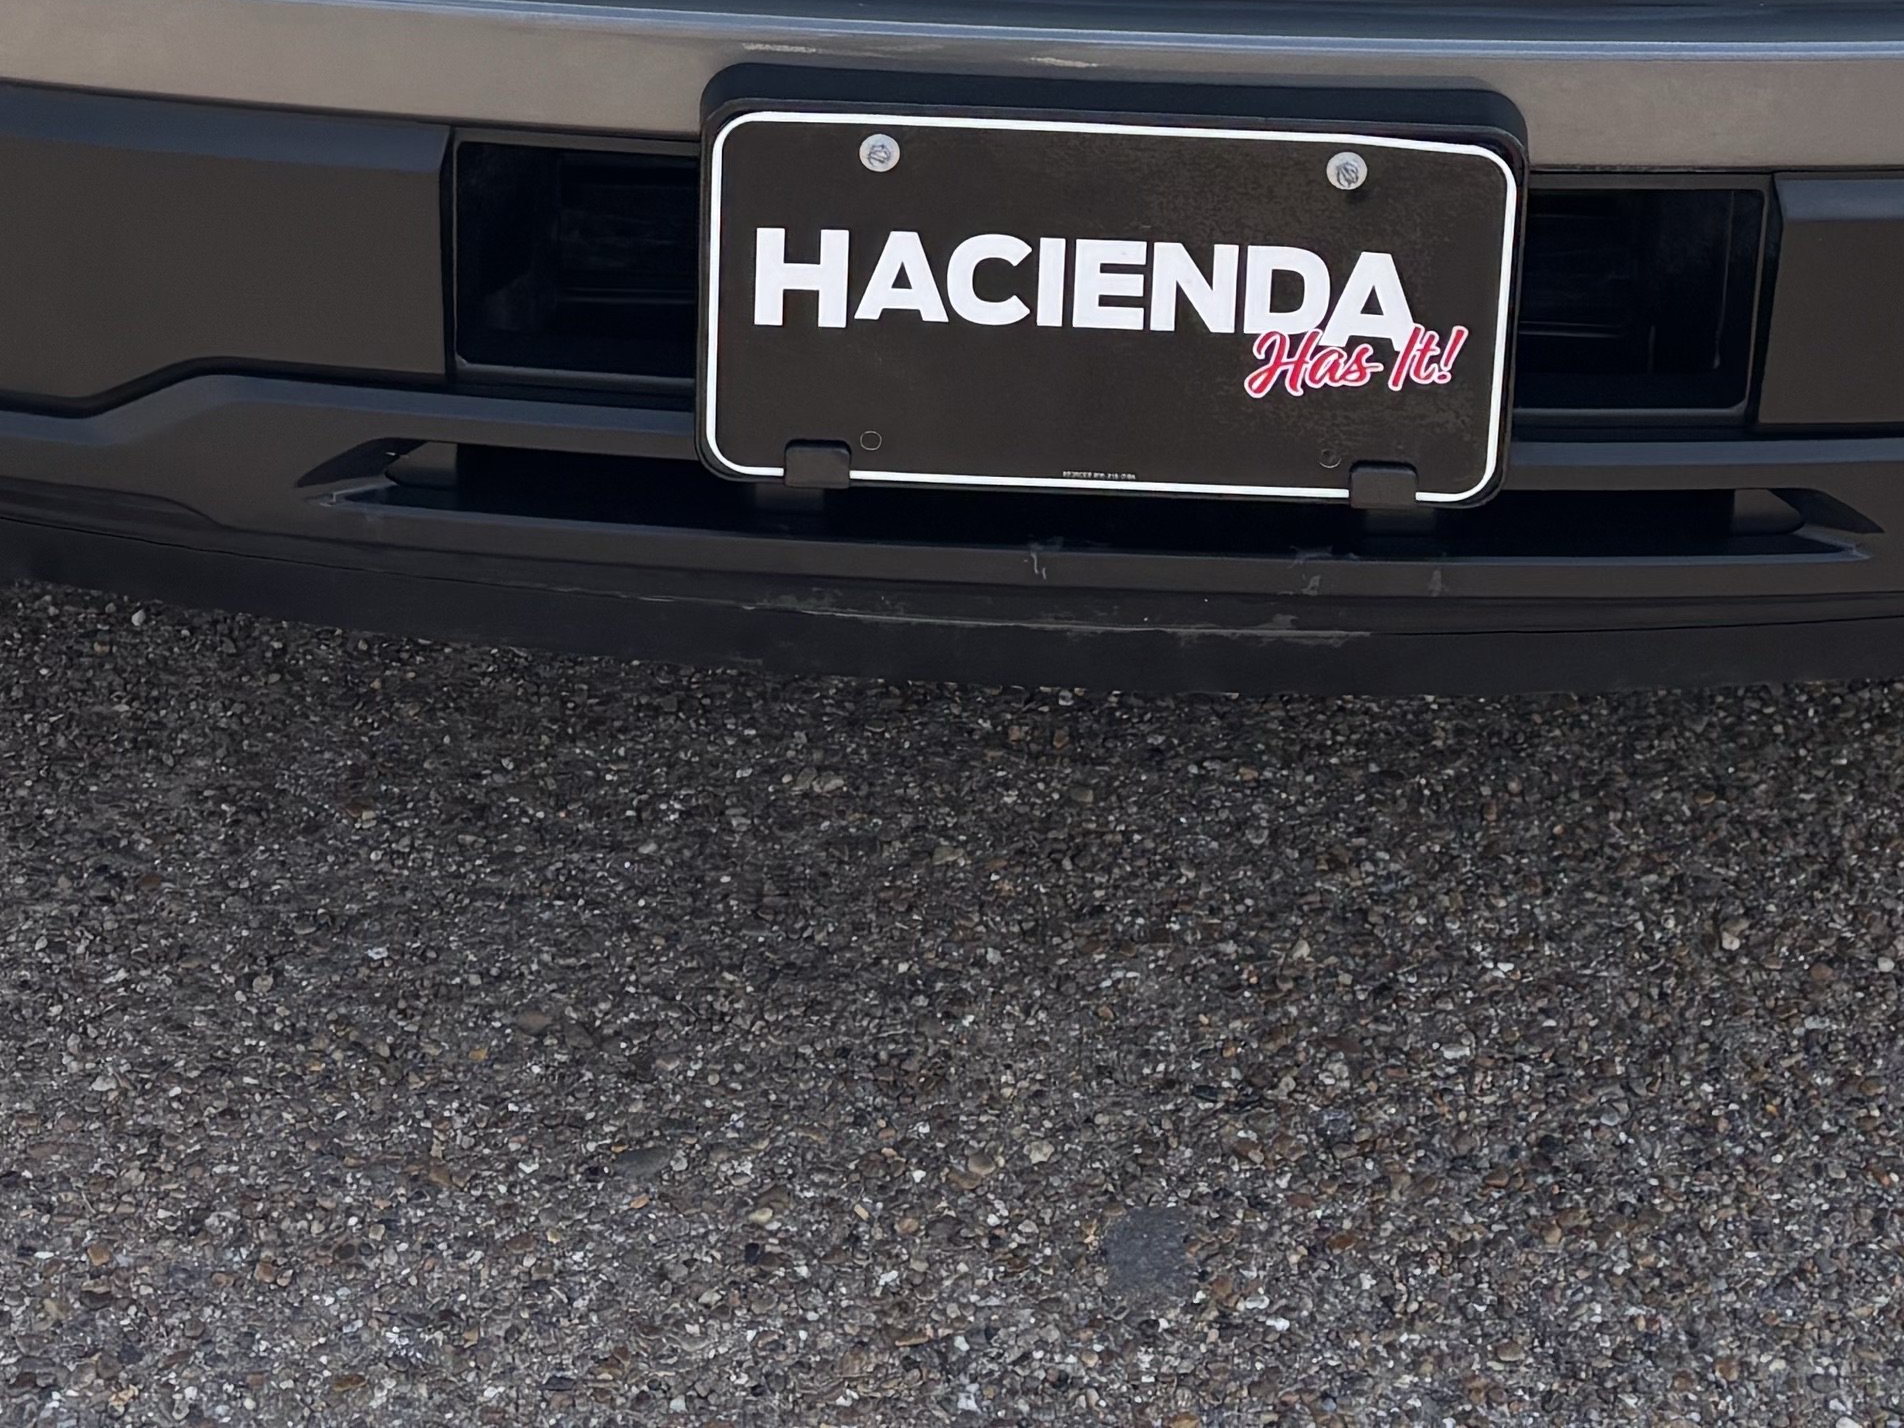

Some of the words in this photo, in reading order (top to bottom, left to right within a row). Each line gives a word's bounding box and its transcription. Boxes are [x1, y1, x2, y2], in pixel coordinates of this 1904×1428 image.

[753, 227, 1419, 350] HACIENDA
[1244, 328, 1384, 398] Has
[1388, 322, 1469, 391] It!
